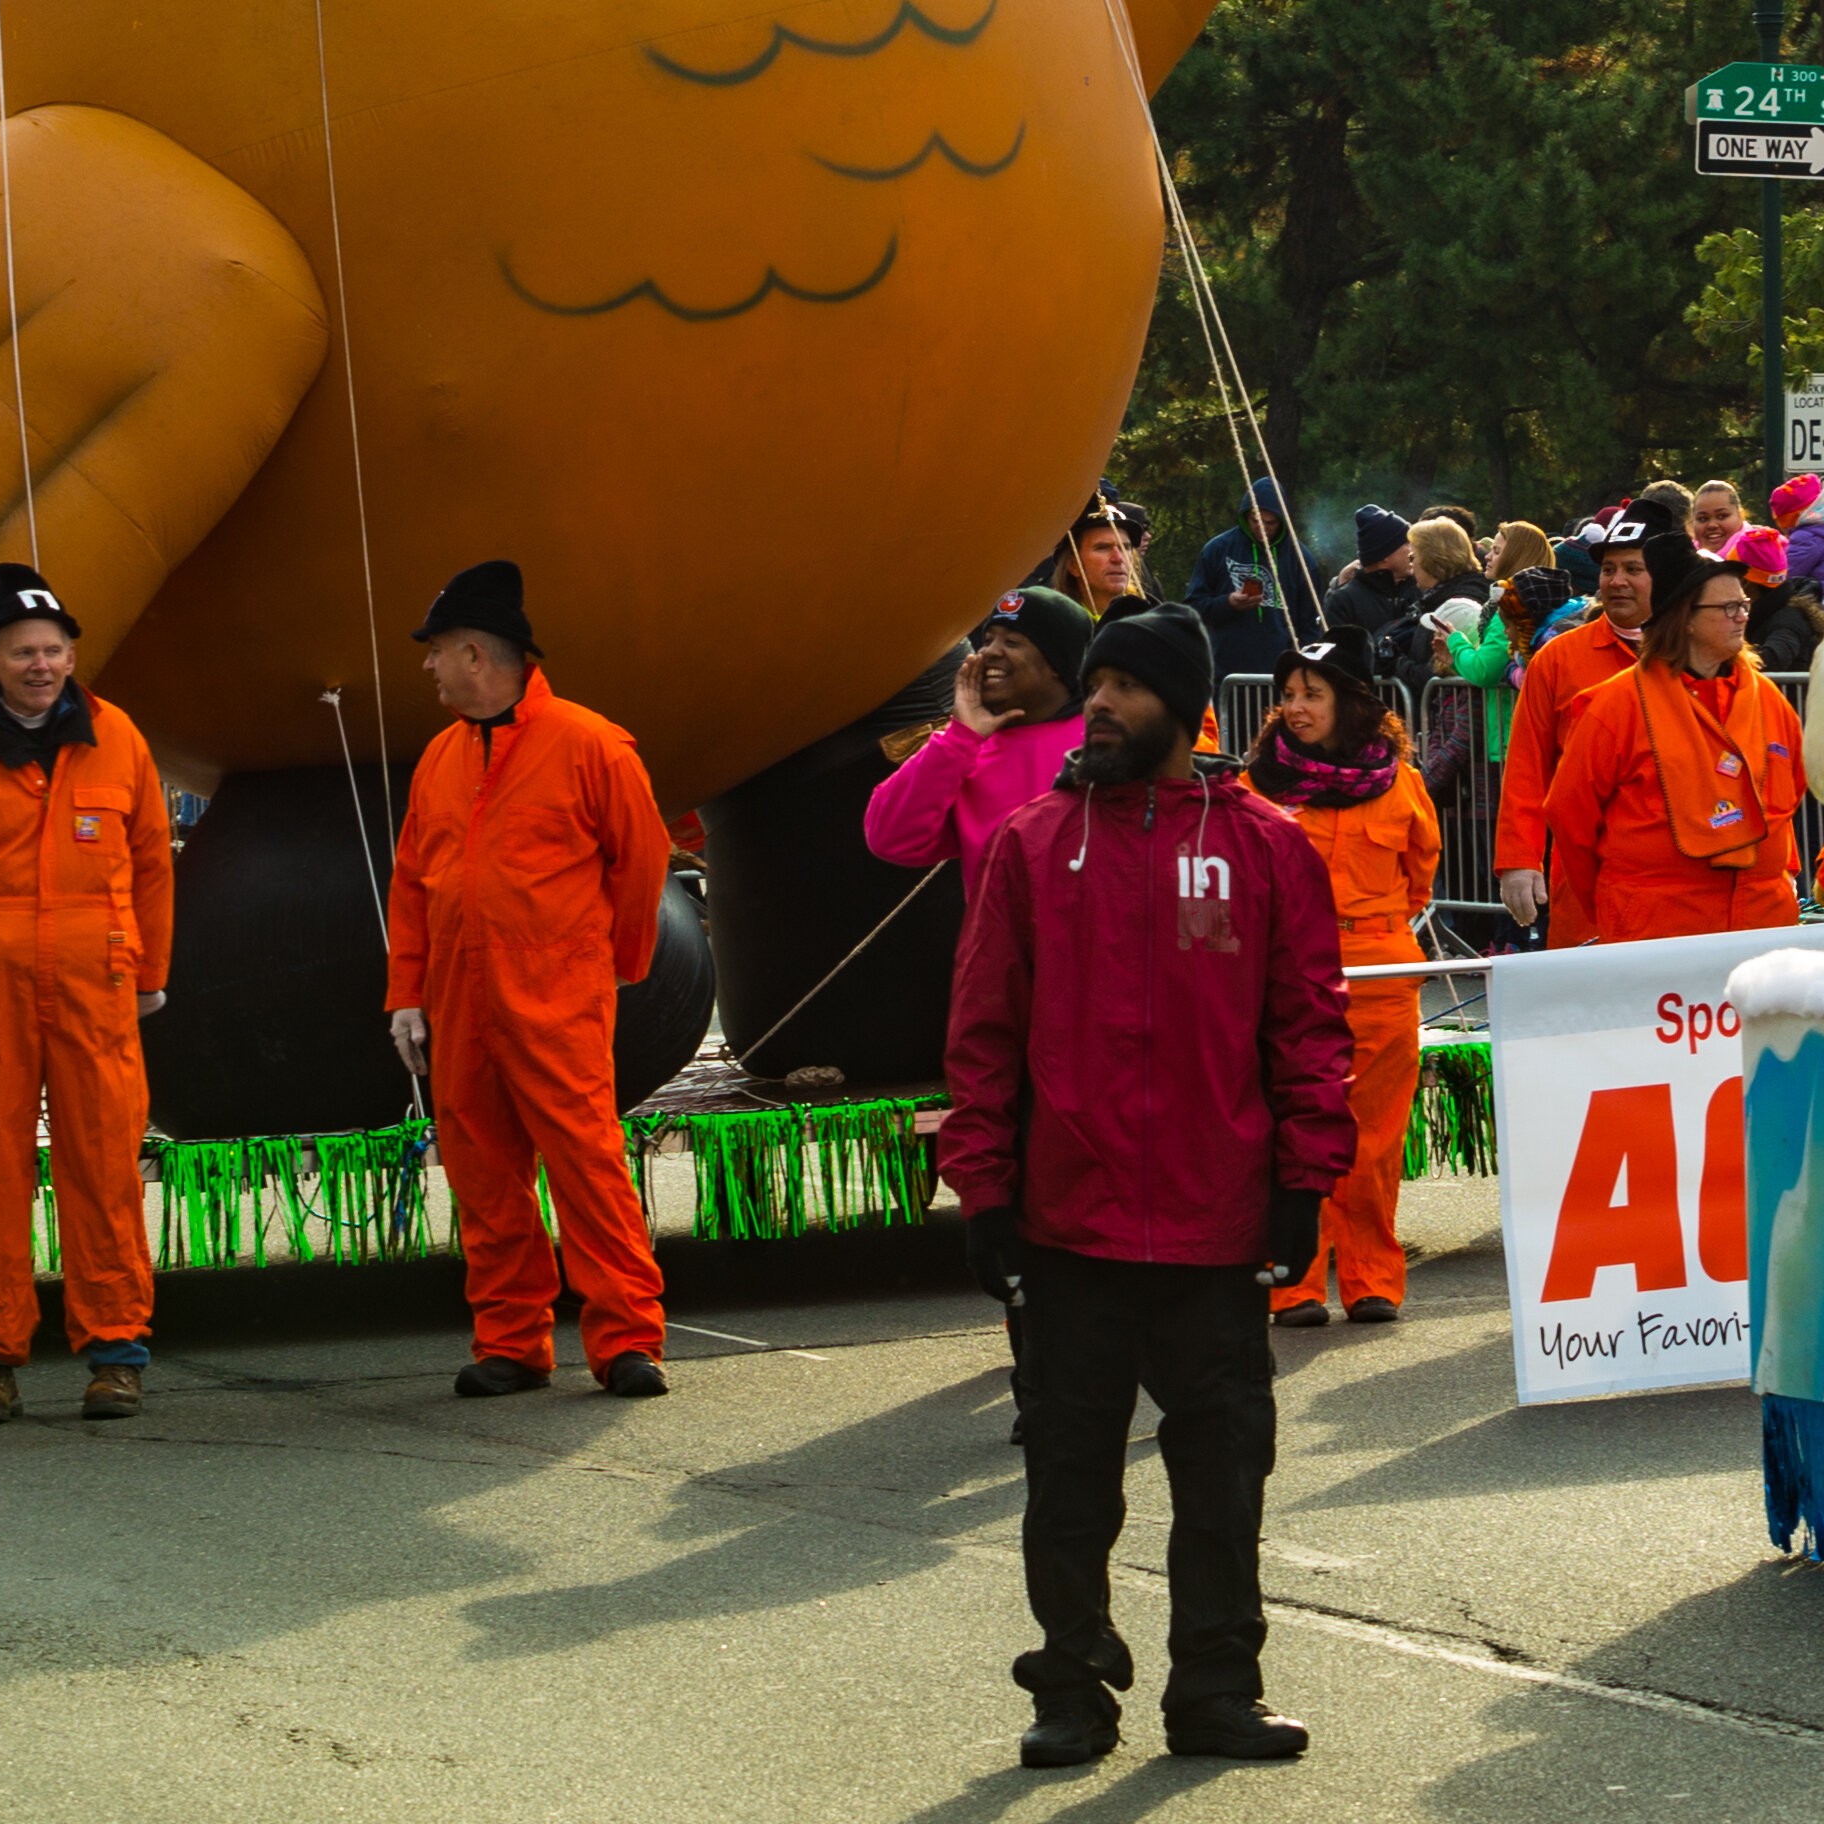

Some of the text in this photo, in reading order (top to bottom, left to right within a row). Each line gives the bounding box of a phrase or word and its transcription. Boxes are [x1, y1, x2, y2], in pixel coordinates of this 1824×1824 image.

[1771, 67, 1817, 82] N 300
[1734, 86, 1806, 117] 24TH
[1716, 137, 1808, 160] ONE WAY
[1656, 992, 1743, 1054] Spo
[1539, 1322, 1625, 1370] Your
